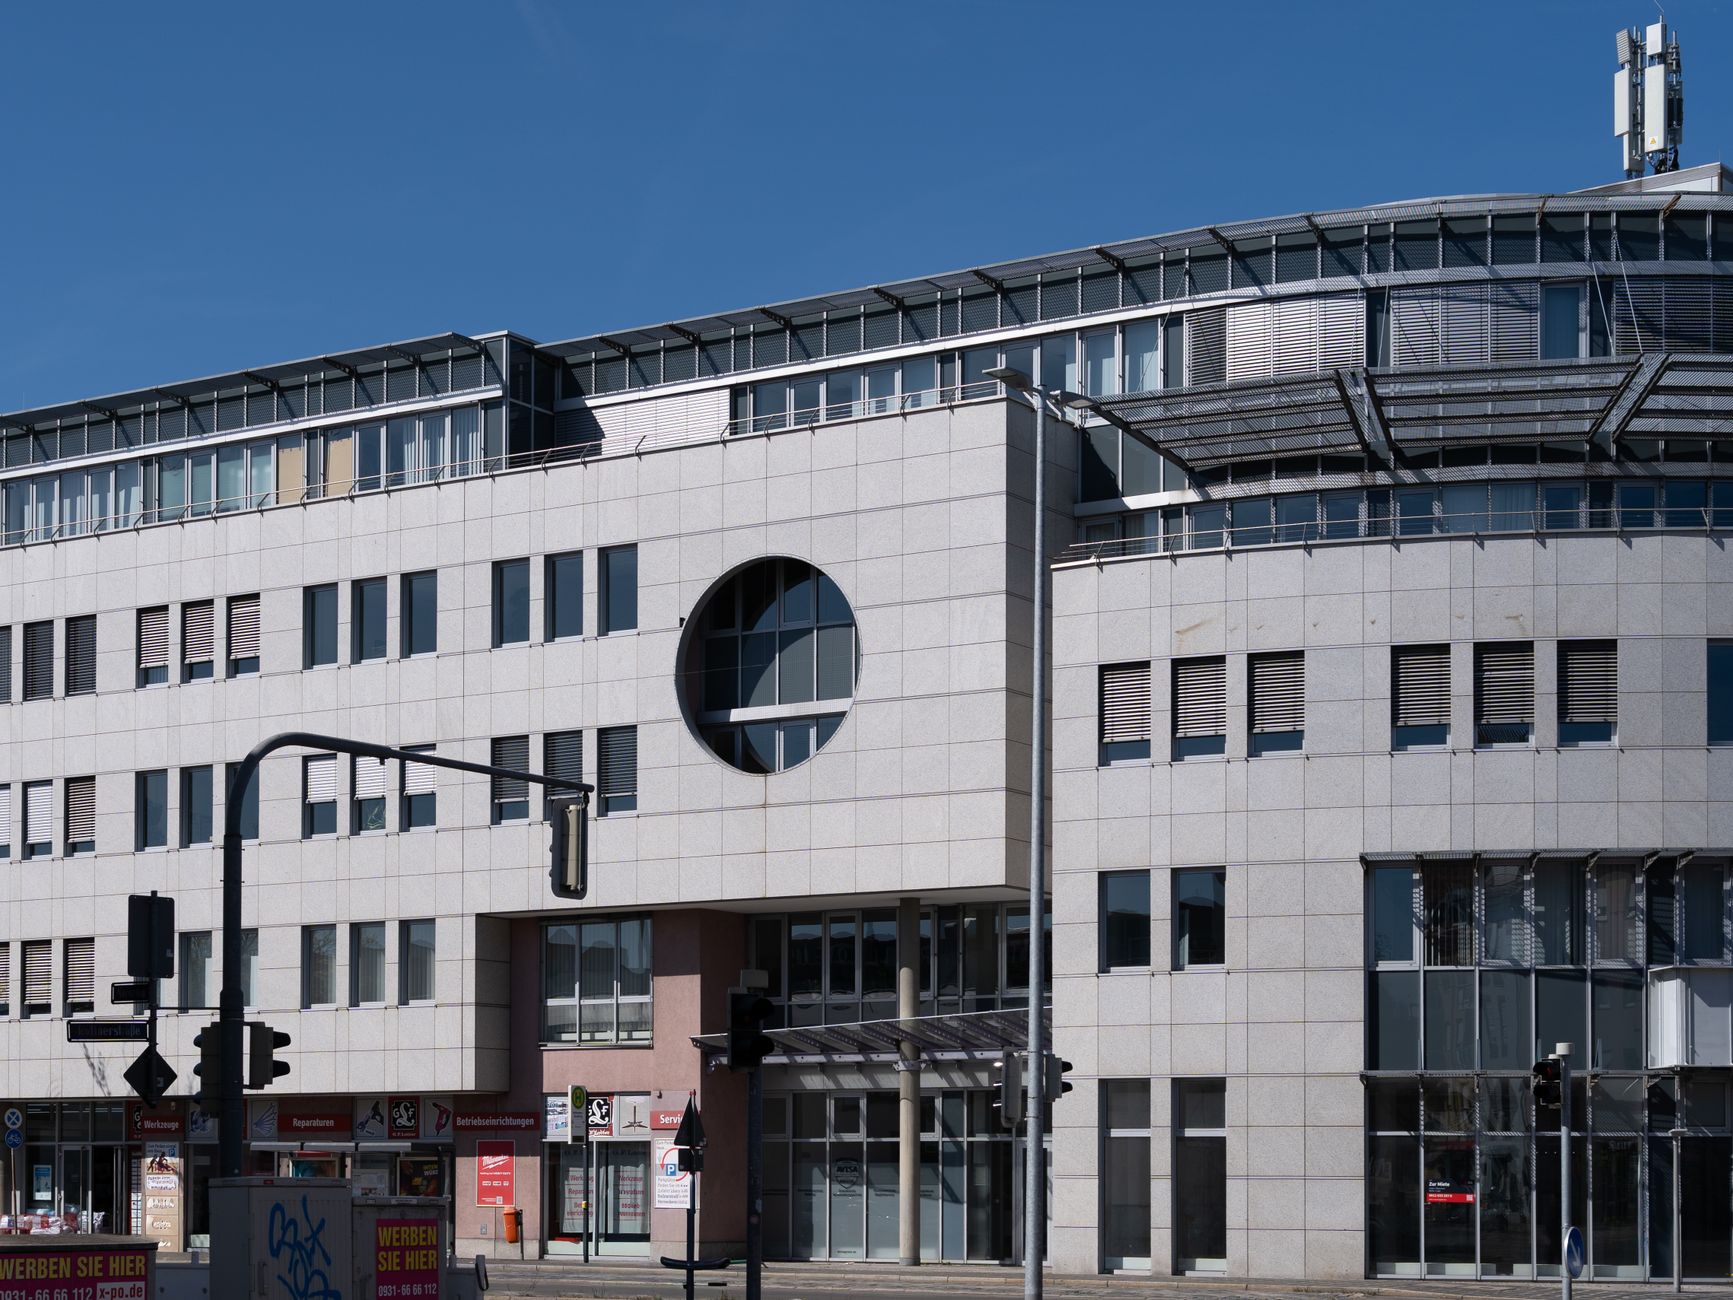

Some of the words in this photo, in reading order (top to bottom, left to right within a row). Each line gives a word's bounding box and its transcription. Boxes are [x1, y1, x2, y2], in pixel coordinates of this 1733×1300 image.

[144, 1120, 179, 1131] Werkzeuge
[293, 1118, 334, 1128] Reparaturen
[456, 1116, 534, 1127] Betriebseinrichtungen
[660, 1115, 683, 1124] Servi
[378, 1225, 437, 1247] WERBEN
[378, 1251, 400, 1271] SIE
[405, 1249, 437, 1270] HIER
[0, 1258, 71, 1280] WERBEN
[77, 1256, 104, 1278] SIE
[109, 1255, 146, 1277] HIER
[53, 1288, 68, 1300] 66
[72, 1287, 93, 1300] 112
[99, 1283, 144, 1300] x-po.de
[412, 1284, 422, 1296] 66
[424, 1283, 437, 1295] 112
